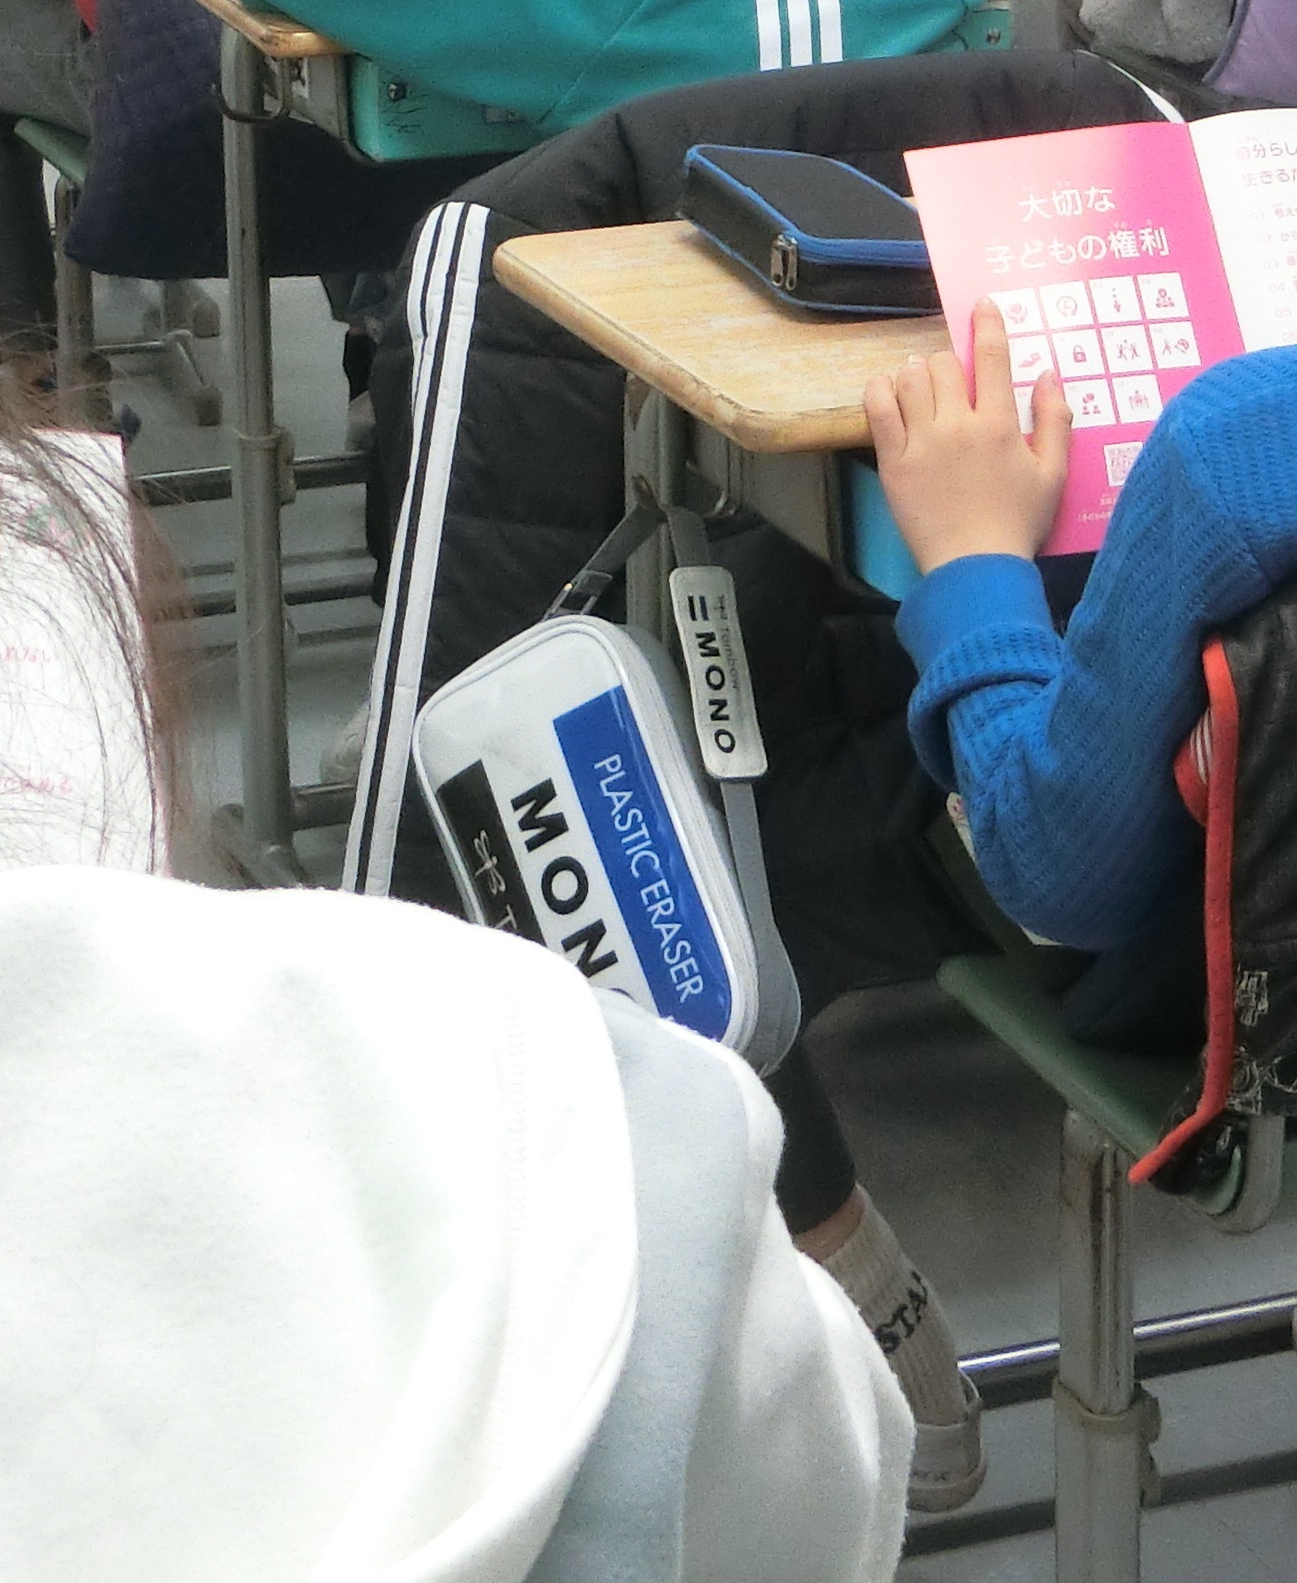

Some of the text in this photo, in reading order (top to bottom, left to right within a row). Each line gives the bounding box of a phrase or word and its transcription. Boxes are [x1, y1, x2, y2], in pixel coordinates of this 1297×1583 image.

[984, 226, 1171, 275] 子どもの権利
[1018, 185, 1117, 223] 大切な
[695, 631, 736, 754] MONO
[510, 778, 637, 1003] MON
[593, 752, 705, 1004] PLASTIC ERASER
